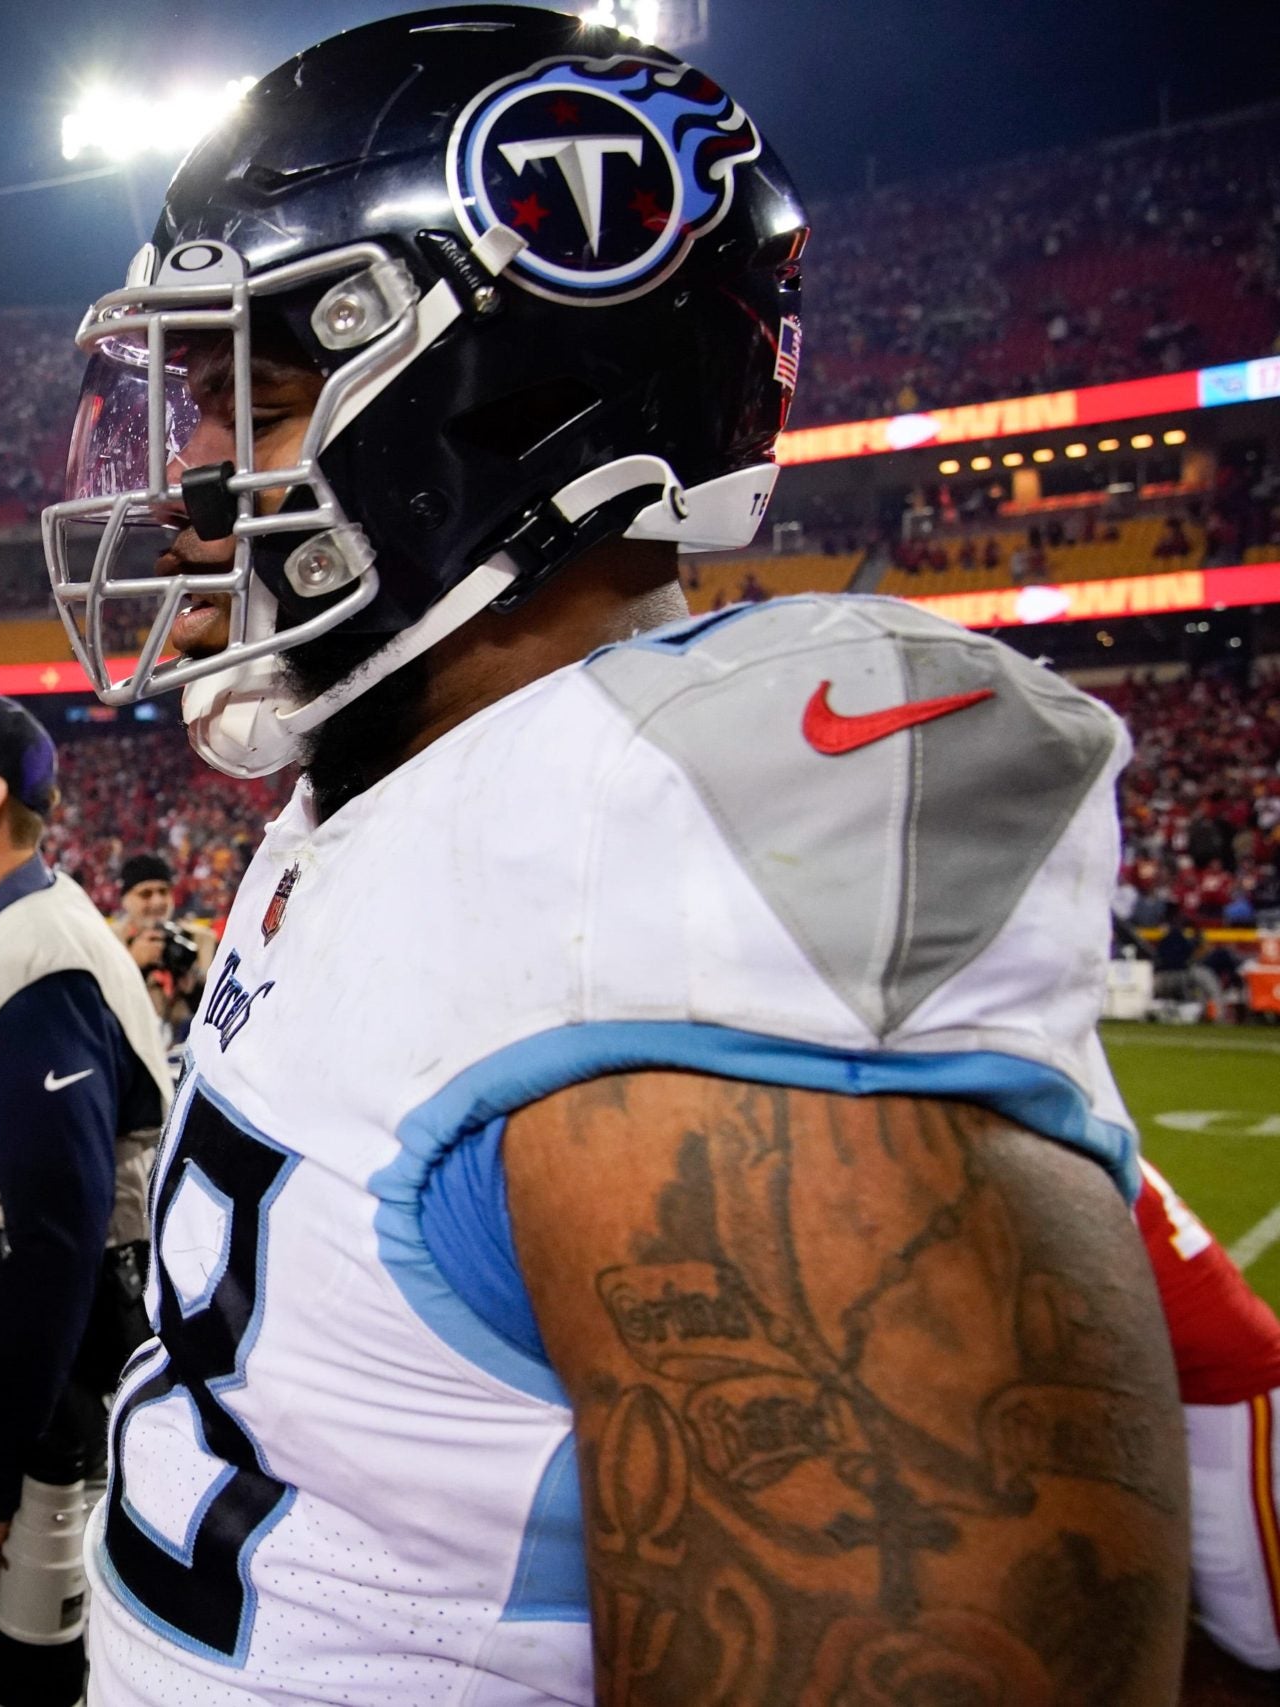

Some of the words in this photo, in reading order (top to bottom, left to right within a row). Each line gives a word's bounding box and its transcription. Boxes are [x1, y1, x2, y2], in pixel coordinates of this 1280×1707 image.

[928, 389, 1078, 443] WIN
[1058, 571, 1204, 617] WIN
[102, 1070, 305, 1670] 8
